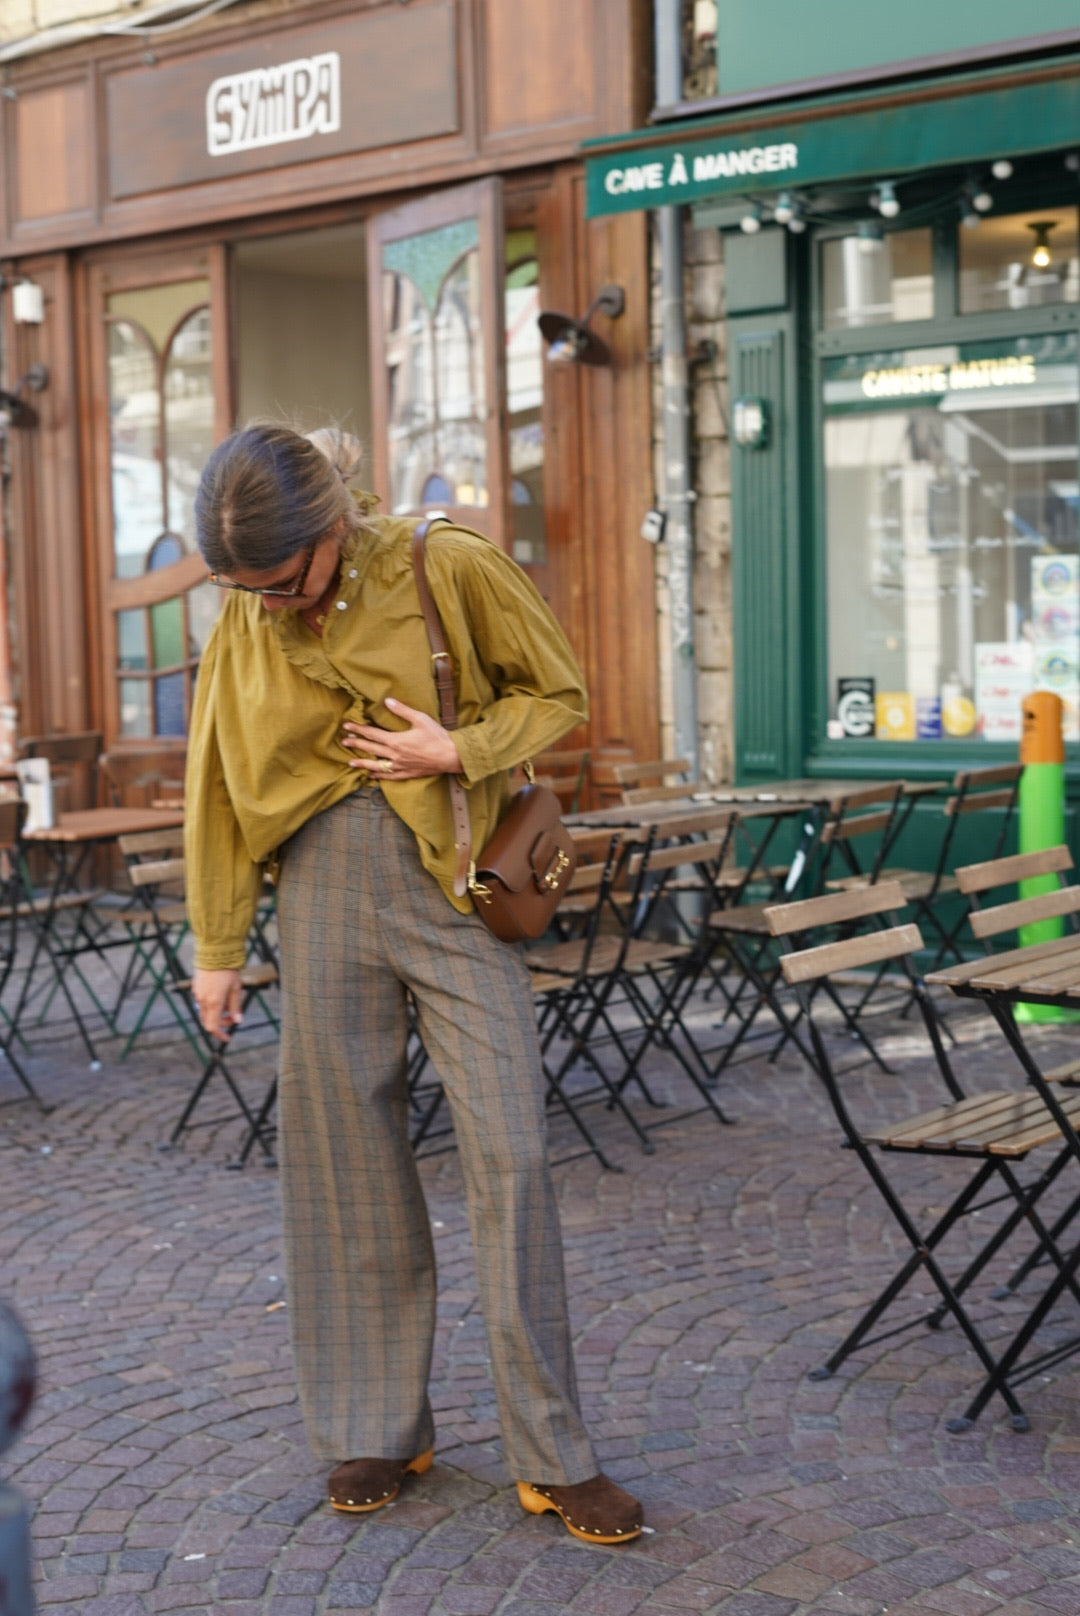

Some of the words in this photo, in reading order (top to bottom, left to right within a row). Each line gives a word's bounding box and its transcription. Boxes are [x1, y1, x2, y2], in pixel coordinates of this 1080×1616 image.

[207, 53, 340, 156] SYMPA
[605, 163, 663, 195] CAVE
[668, 153, 688, 186] À
[693, 143, 798, 182] MANGER
[950, 356, 1035, 390] NATURE
